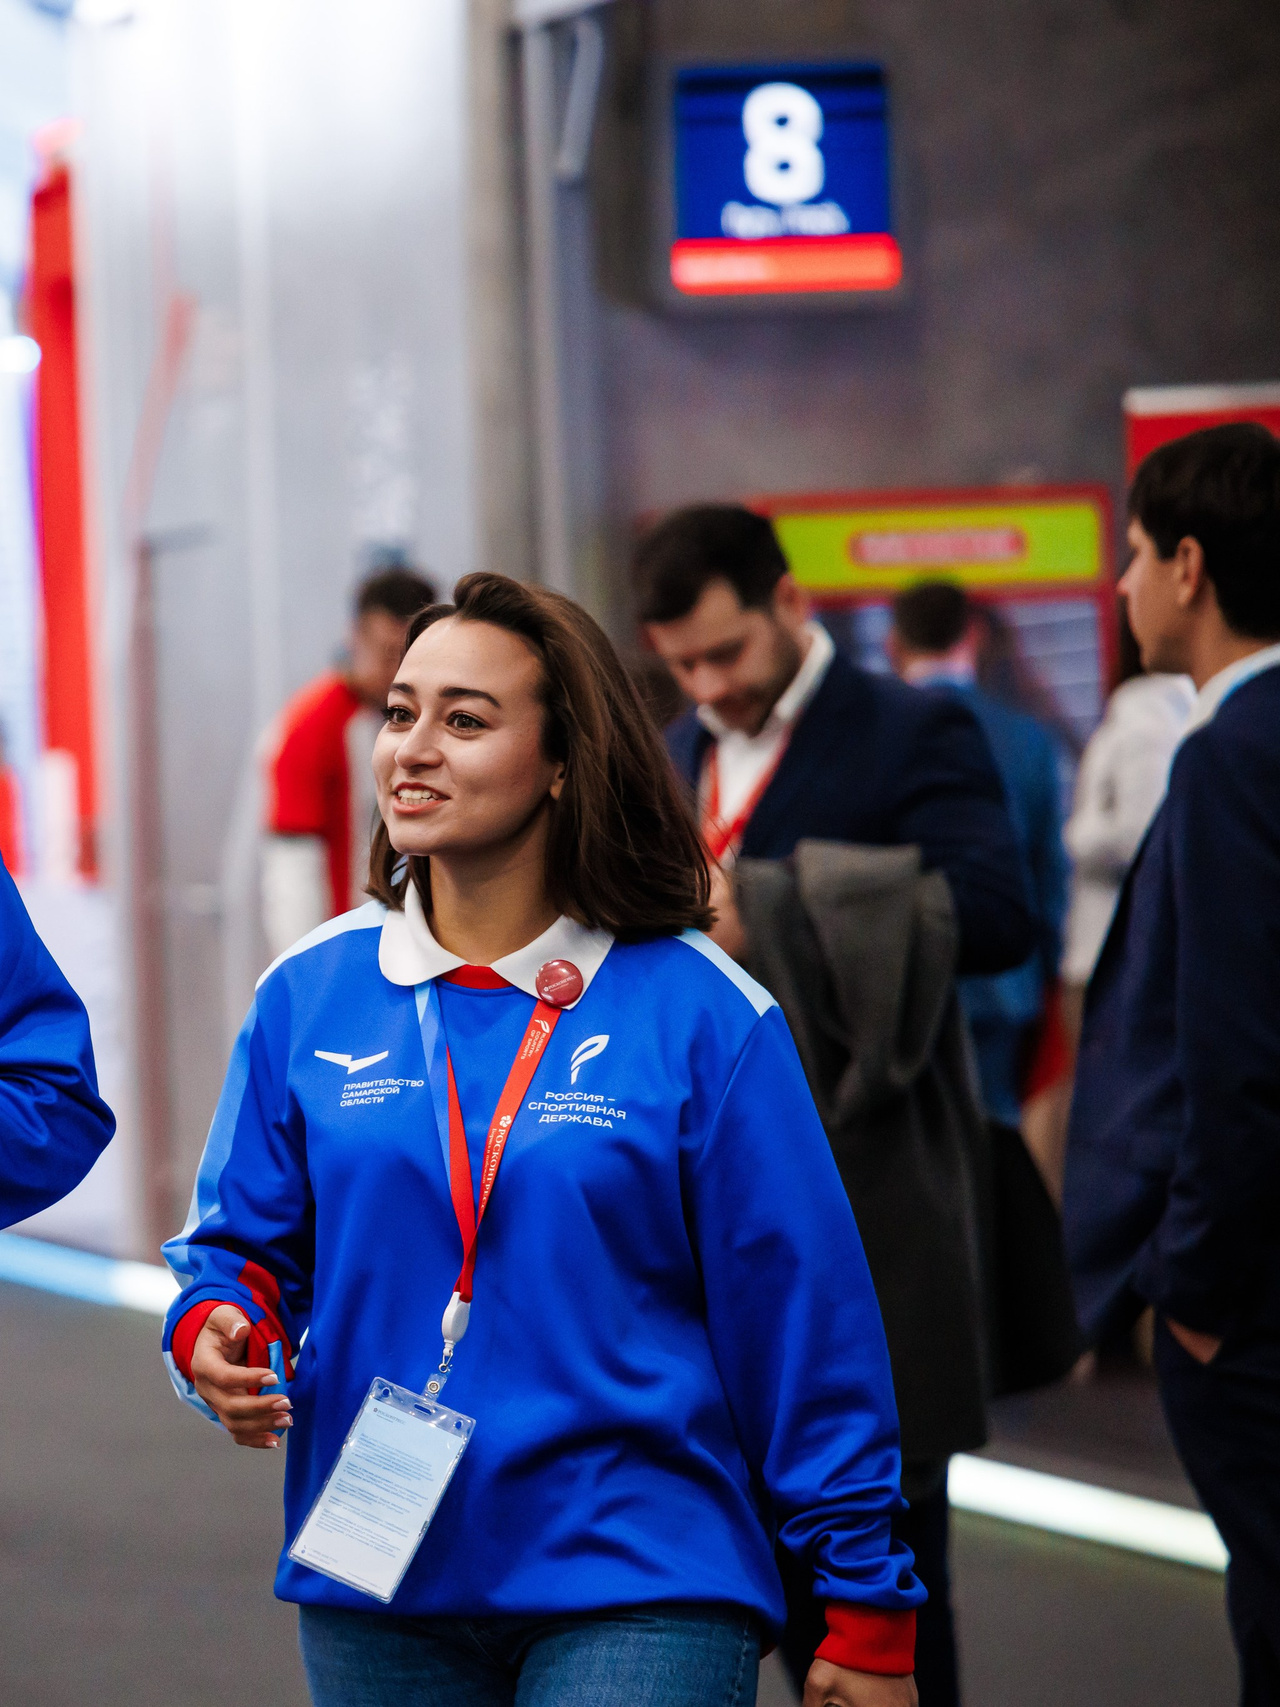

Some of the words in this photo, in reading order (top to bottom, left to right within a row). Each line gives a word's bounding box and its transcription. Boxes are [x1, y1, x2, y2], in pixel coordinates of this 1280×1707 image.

[742, 81, 825, 206] 8
[343, 1078, 425, 1091] ПРАВИТЕЛЬСТВО
[341, 1086, 400, 1099] САМАРСКОЙ
[544, 1091, 605, 1103] РОССИЯ
[340, 1096, 385, 1107] ОБЛАСТИ
[527, 1101, 627, 1120] СПОРТИВНАЯ
[538, 1114, 614, 1129] ДЕРЖАВА
